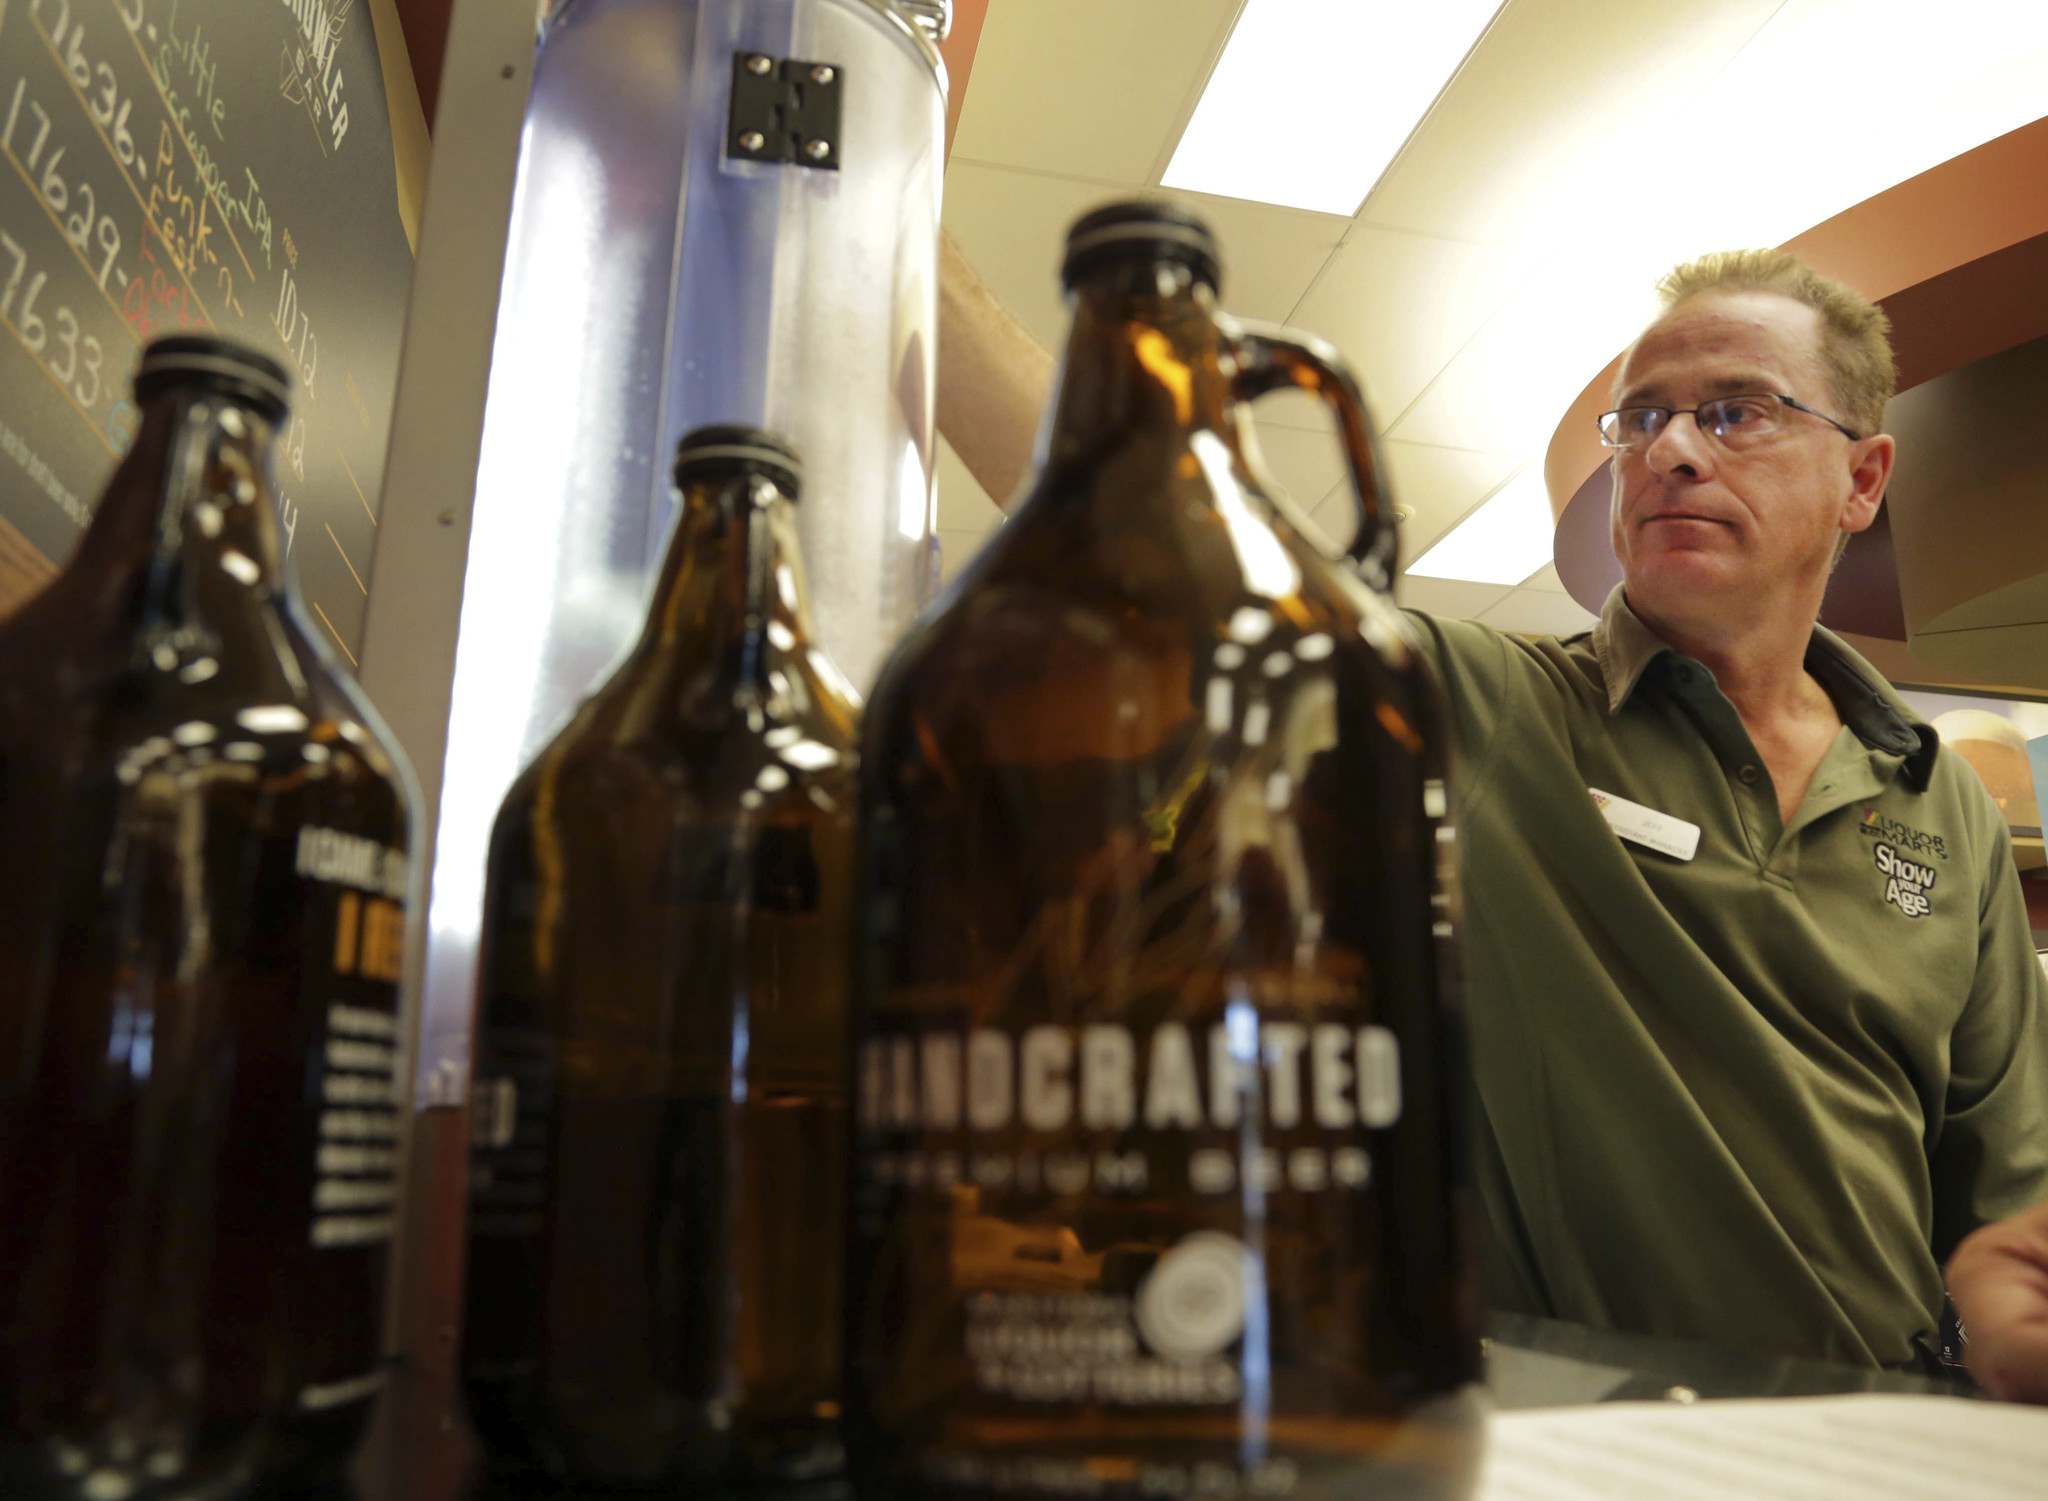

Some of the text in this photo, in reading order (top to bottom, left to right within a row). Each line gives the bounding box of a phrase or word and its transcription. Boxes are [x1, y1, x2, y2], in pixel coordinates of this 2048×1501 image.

[239, 167, 272, 271] IPA
[1880, 815, 1945, 848] LIQUOR
[1881, 829, 1949, 860] MARTS
[1875, 844, 1935, 888] Show
[1886, 878, 1930, 916] Age
[1897, 878, 1923, 894] your
